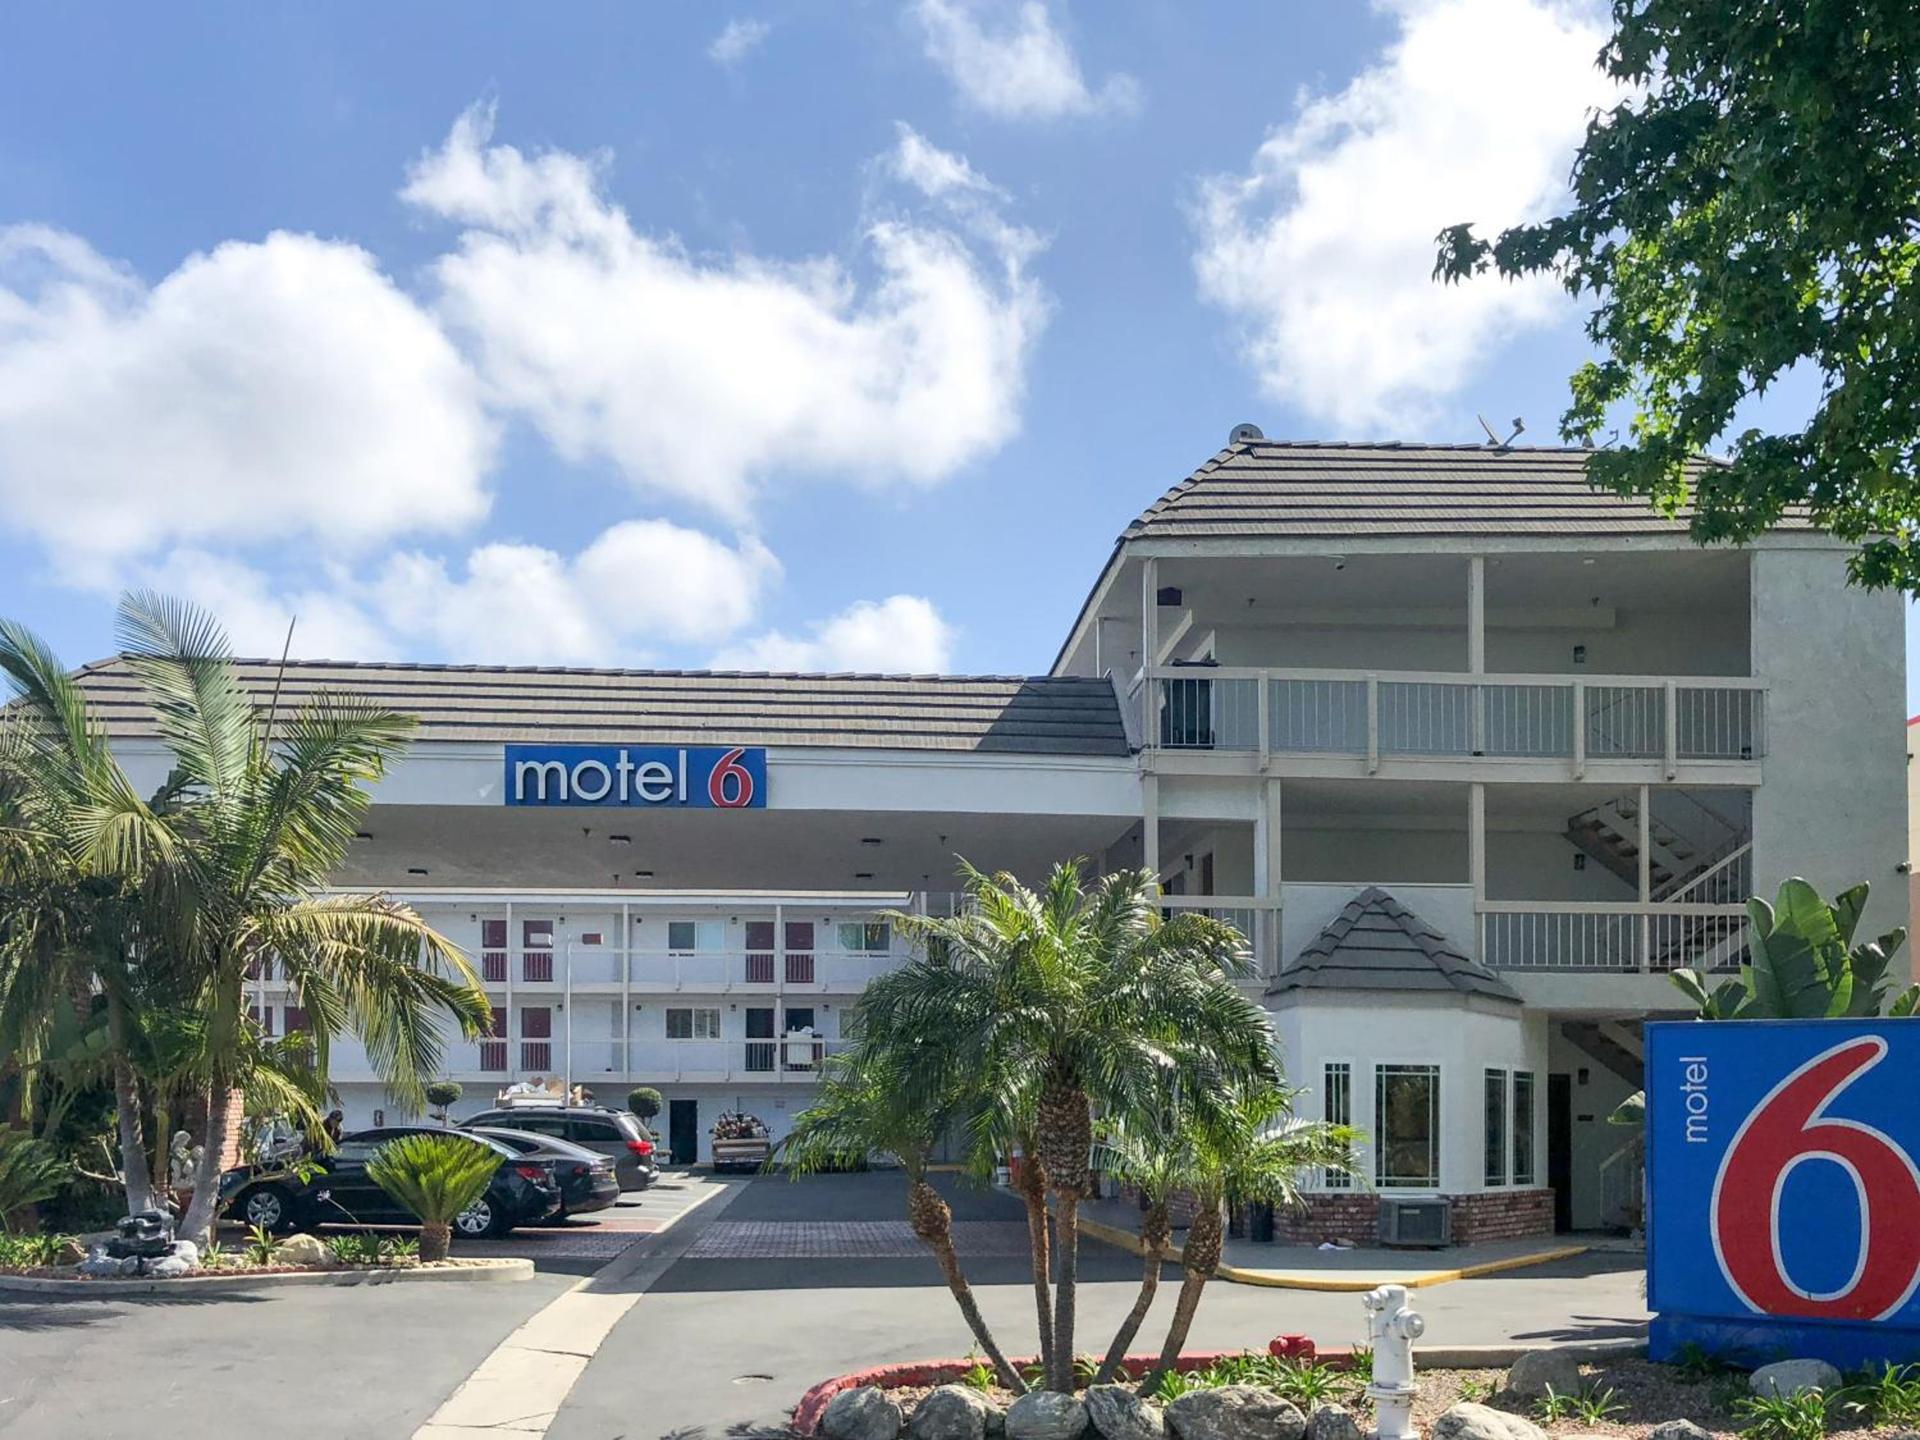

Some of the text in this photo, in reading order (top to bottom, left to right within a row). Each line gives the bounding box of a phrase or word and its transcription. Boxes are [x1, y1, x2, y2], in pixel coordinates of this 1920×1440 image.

[515, 746, 753, 808] motel 6
[1679, 1057, 1708, 1143] motel
[1709, 1034, 1920, 1322] 6
